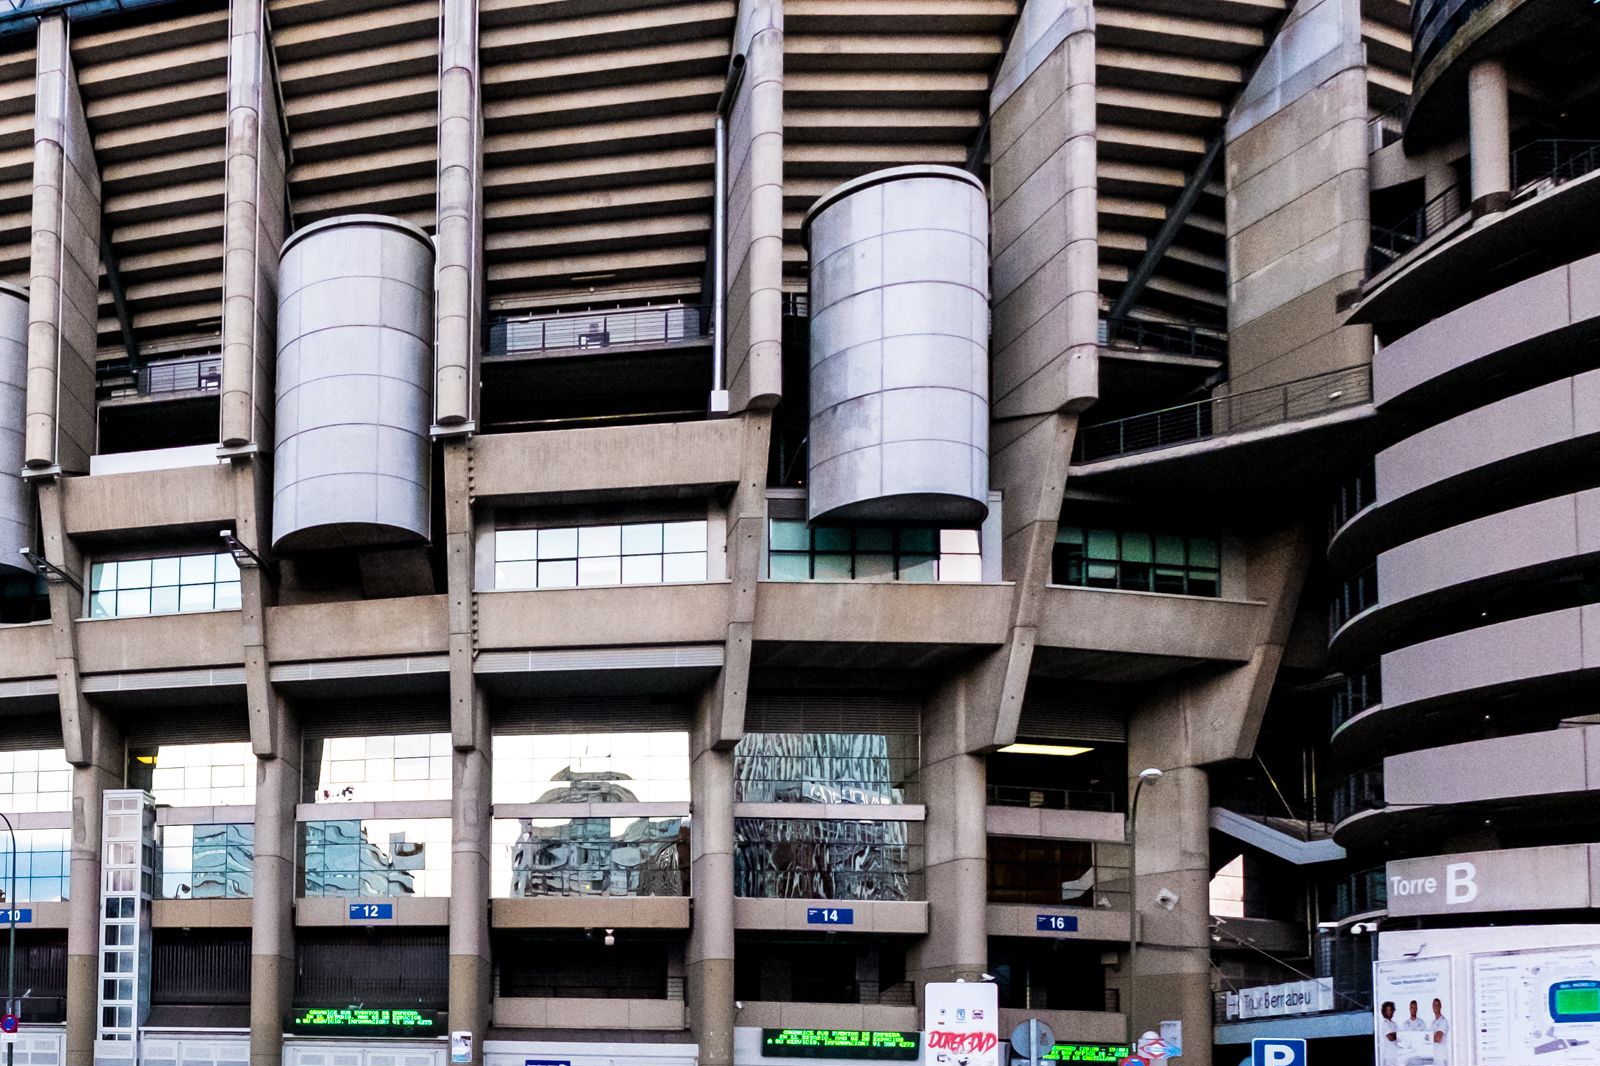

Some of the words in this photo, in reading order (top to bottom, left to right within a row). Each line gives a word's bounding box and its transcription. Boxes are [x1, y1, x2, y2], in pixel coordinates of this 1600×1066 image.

[1389, 875, 1438, 896] Torre
[1445, 861, 1479, 905] B
[7, 910, 20, 921] 10
[363, 905, 379, 917] 12
[821, 909, 838, 922] 14
[1049, 916, 1065, 930] 16
